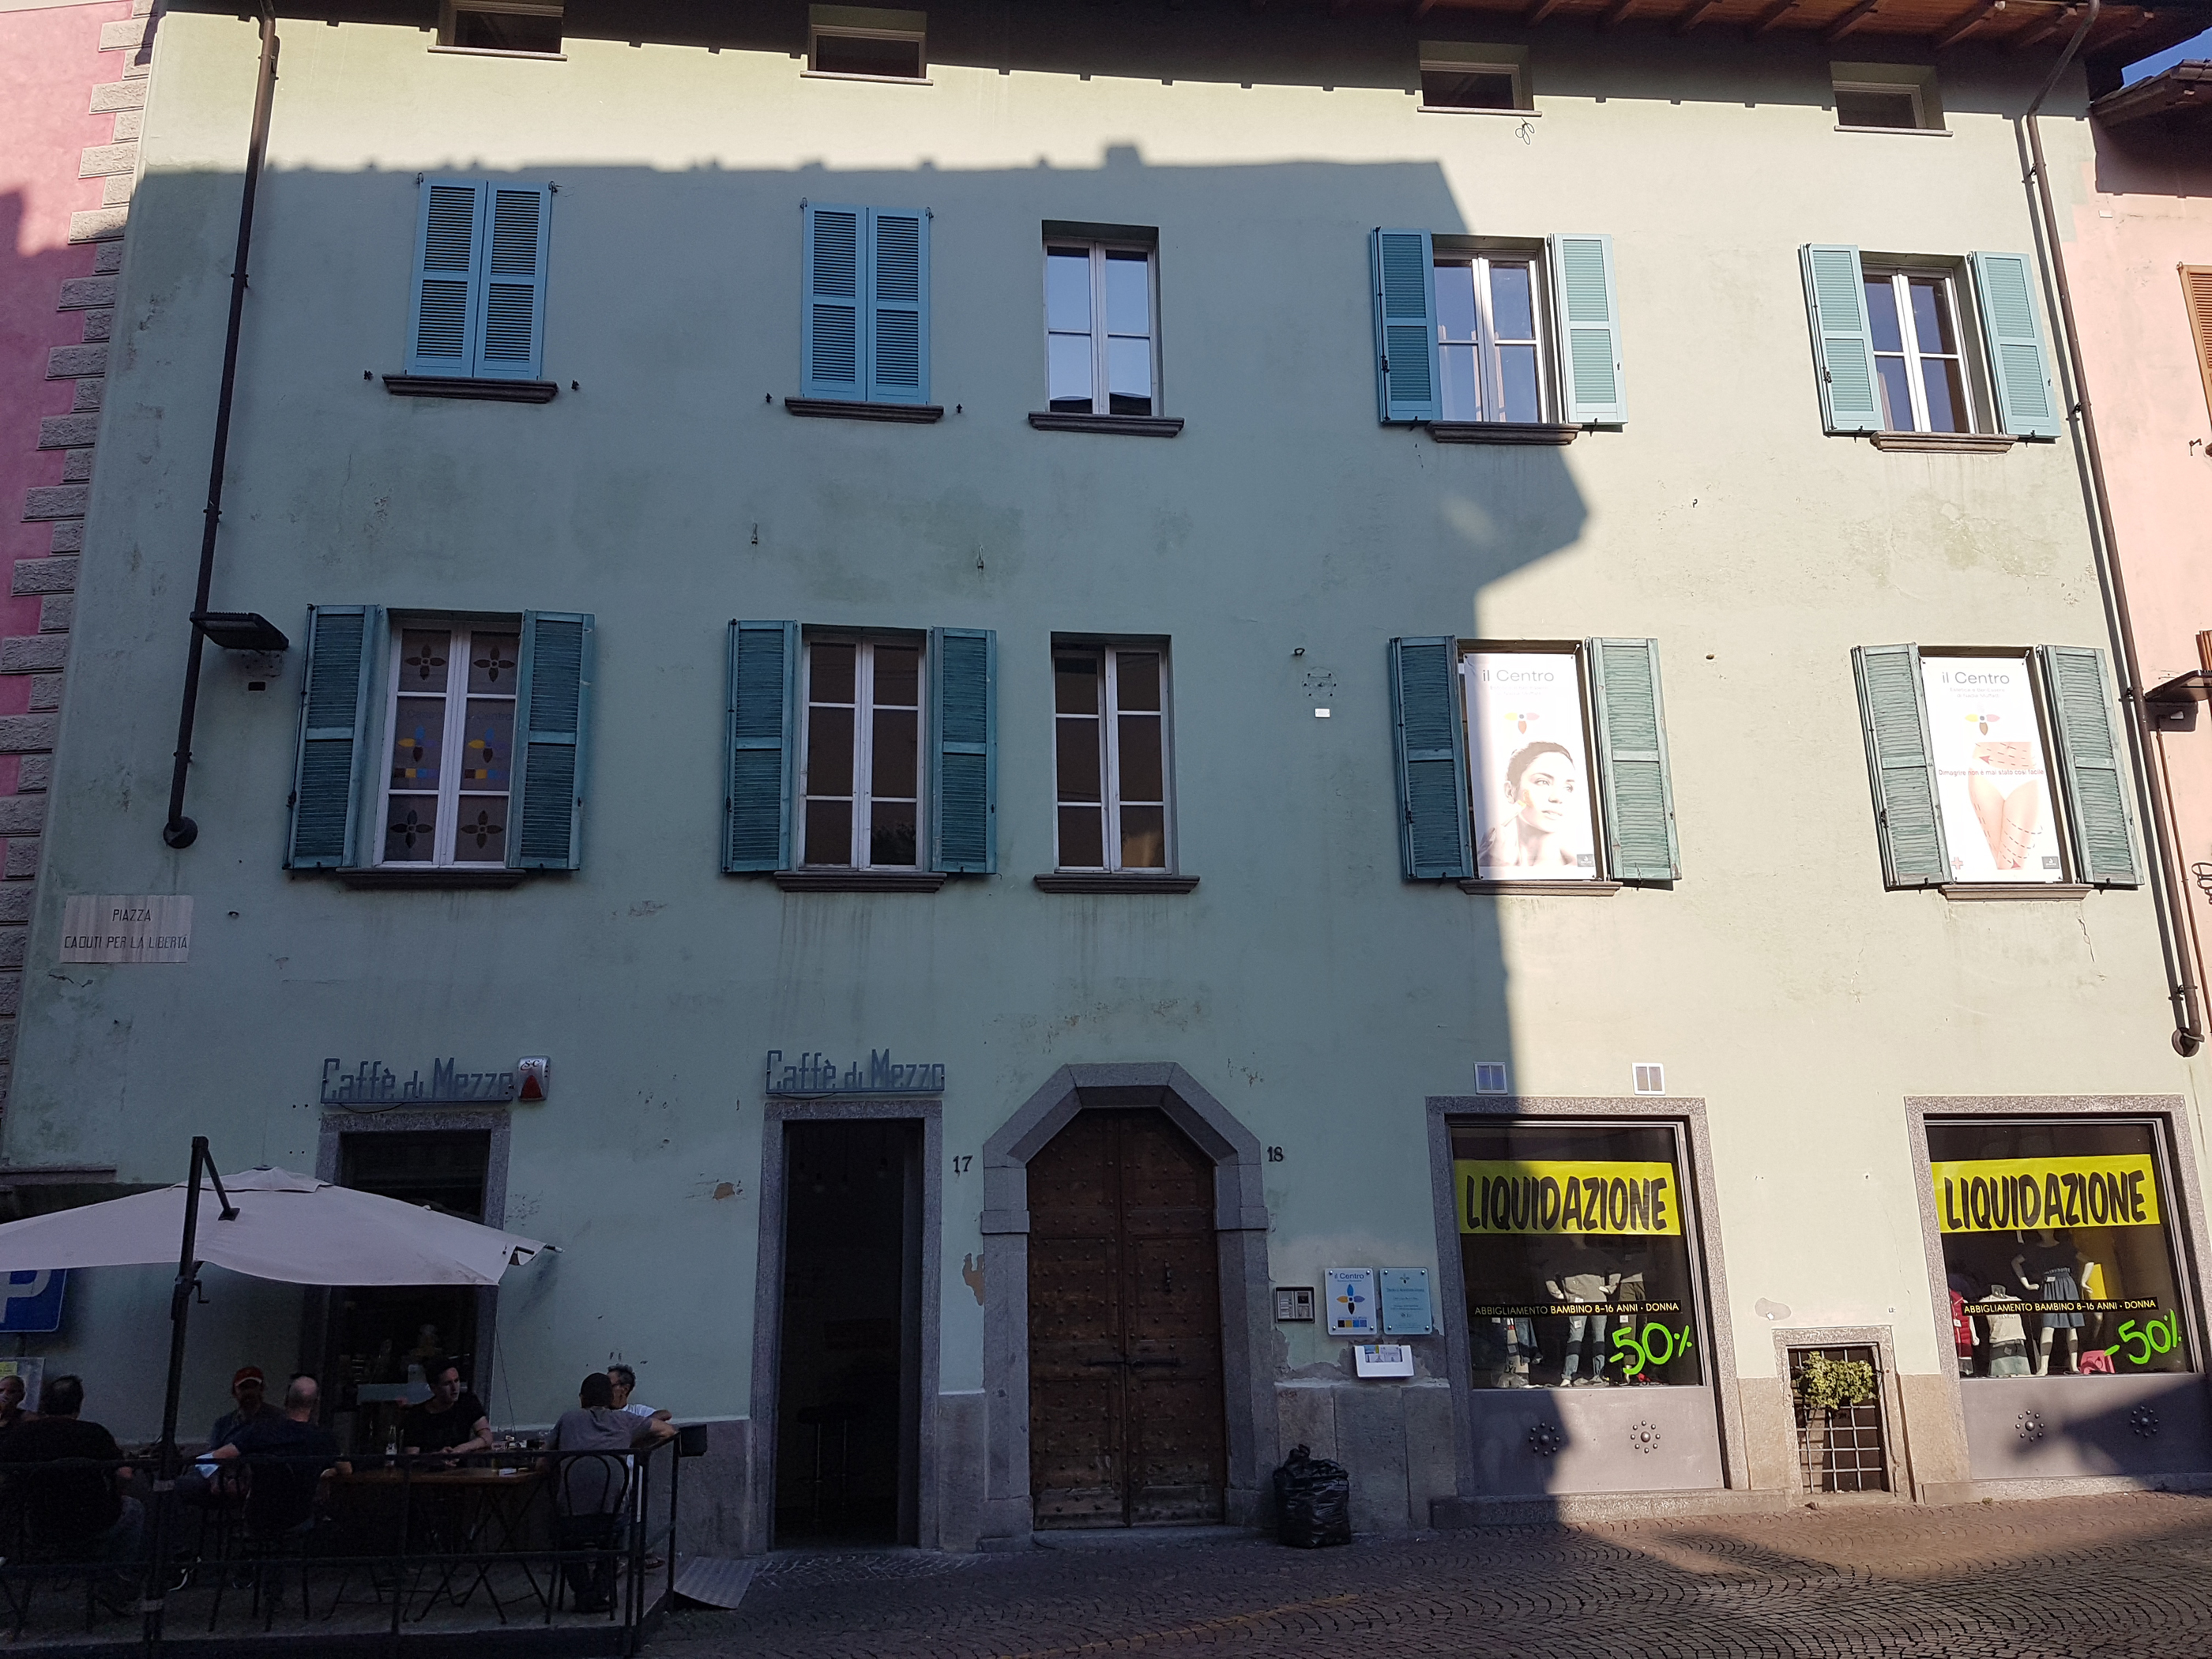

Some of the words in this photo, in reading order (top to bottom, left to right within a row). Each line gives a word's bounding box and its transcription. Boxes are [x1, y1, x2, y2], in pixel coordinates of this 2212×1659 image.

[1482, 669, 1491, 683] il
[1495, 668, 1555, 683] Centro
[1941, 672, 1950, 683] il
[1954, 671, 2011, 685] Centro
[1938, 769, 1966, 777] Dimagrire
[112, 908, 152, 922] PIAZZA
[64, 935, 102, 949] CADUTI
[107, 935, 126, 948] PER
[130, 935, 144, 949] LA
[766, 1049, 837, 1094] Caffè
[844, 1061, 863, 1091] di
[871, 1048, 945, 1092] Mezzo
[320, 1057, 396, 1104] Caffè
[403, 1070, 424, 1100] di
[432, 1057, 514, 1102] Mezzo
[1266, 1146, 1284, 1162] 18
[952, 1155, 973, 1174] 17
[1466, 1176, 1668, 1231] LIQUIDAZIONE
[1943, 1169, 2147, 1230] LIQUIDAZIONE
[1474, 1306, 1548, 1315] ABBIGLIAMENTO
[1550, 1304, 1593, 1315] BAMBINO
[1594, 1304, 1615, 1314] 8-16
[1616, 1304, 1638, 1313] ANNI
[1646, 1302, 1680, 1311] DONNA
[1964, 1303, 2033, 1315] ABBIGLIAMENTO
[2034, 1302, 2075, 1312] BAMBINO
[2076, 1301, 2095, 1311] 8-16
[2097, 1301, 2118, 1311] ANNI
[2124, 1299, 2157, 1310] DONNA
[2103, 1308, 2183, 1365] -50%
[1609, 1322, 1693, 1375] -50%
